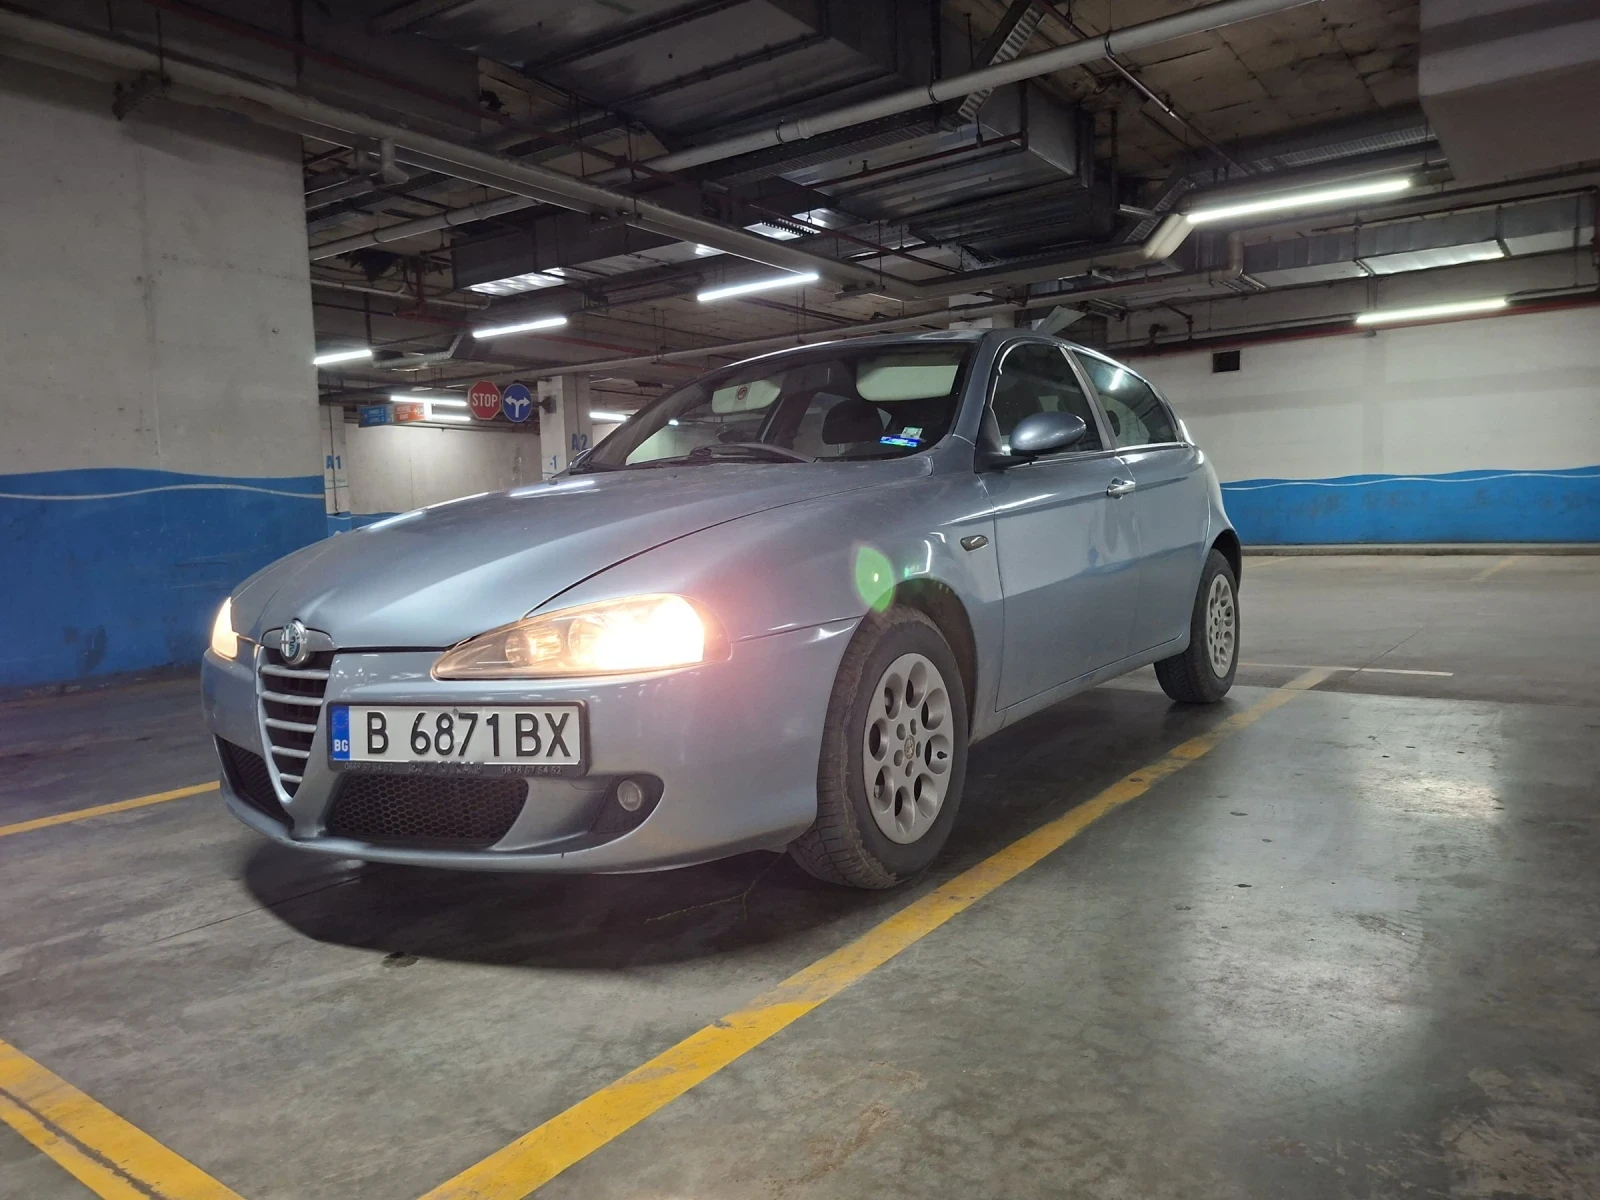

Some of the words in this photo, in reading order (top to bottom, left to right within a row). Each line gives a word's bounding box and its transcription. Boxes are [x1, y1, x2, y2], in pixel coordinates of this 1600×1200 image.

[472, 392, 498, 407] STOP
[571, 433, 588, 451] A2
[326, 455, 342, 470] A1
[367, 711, 389, 755] B
[410, 711, 500, 758] 6871
[515, 712, 571, 758] BX
[333, 738, 349, 752] BG
